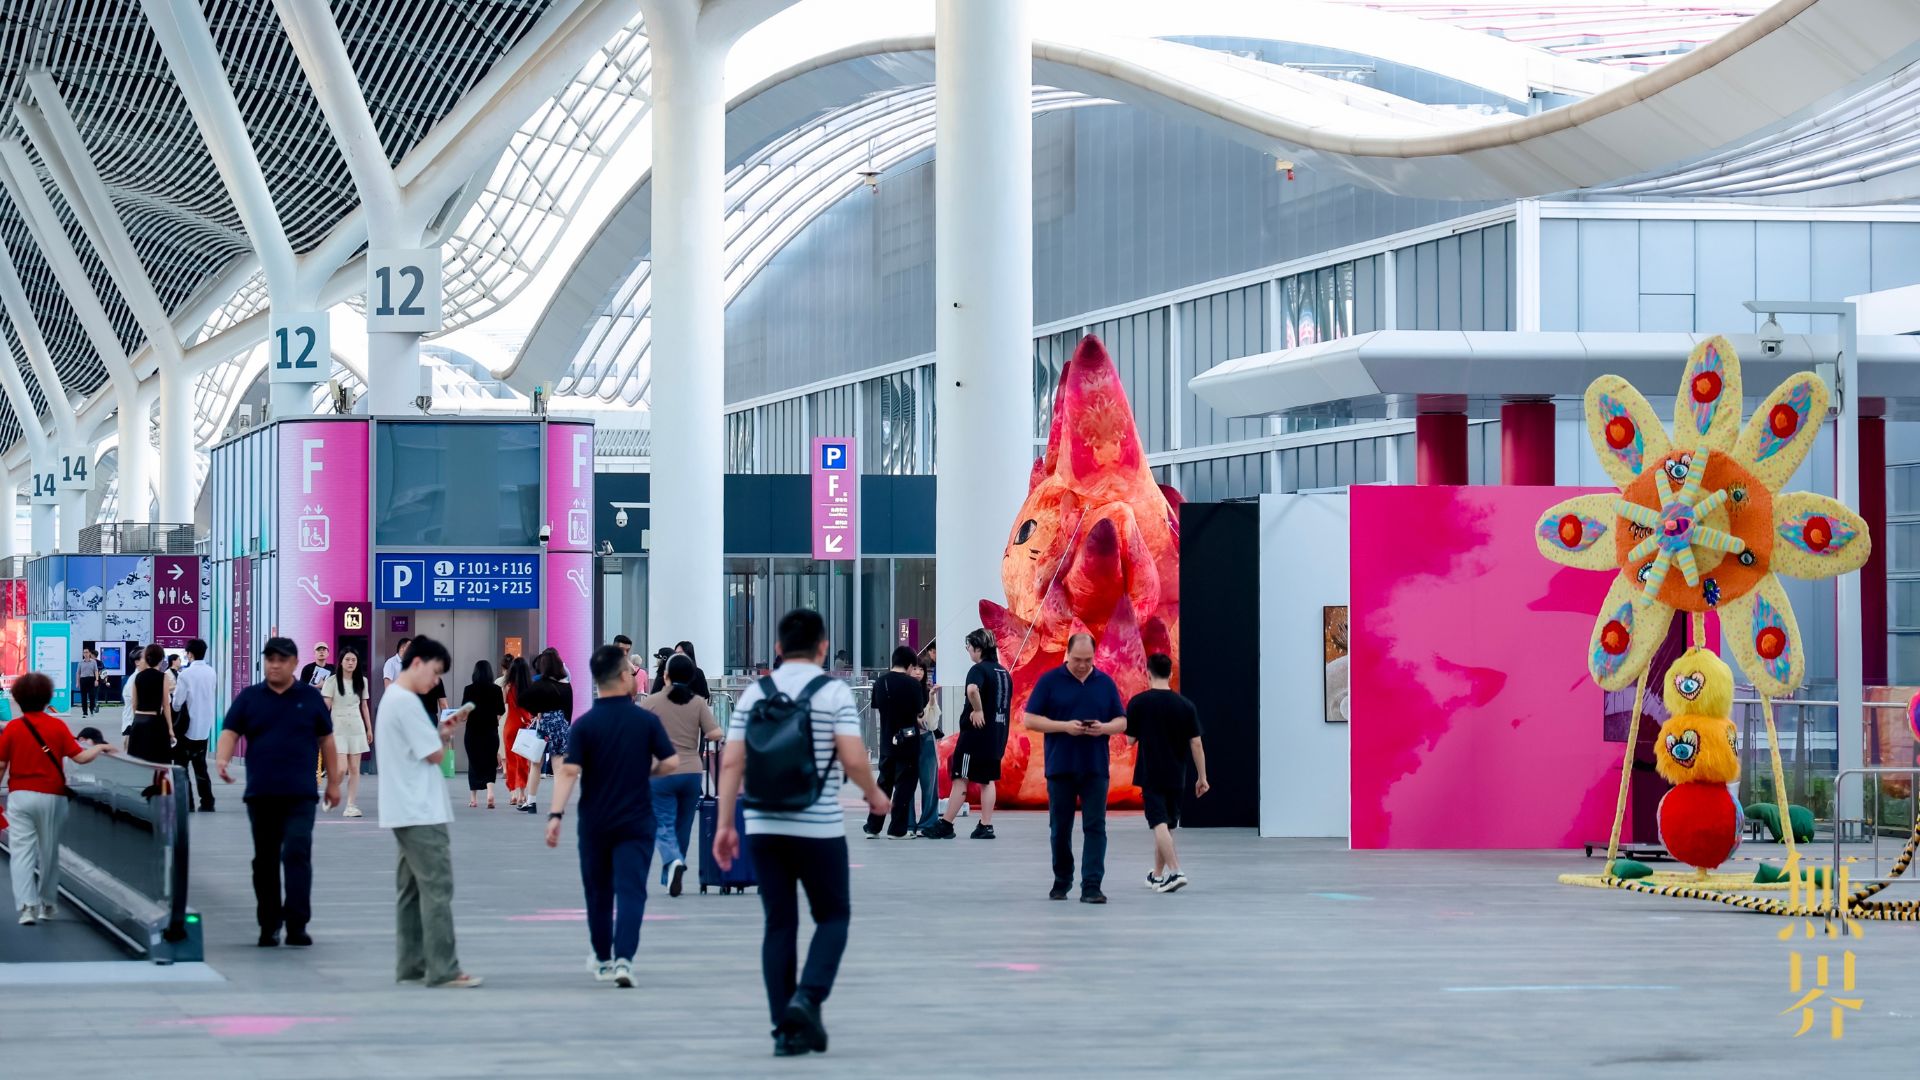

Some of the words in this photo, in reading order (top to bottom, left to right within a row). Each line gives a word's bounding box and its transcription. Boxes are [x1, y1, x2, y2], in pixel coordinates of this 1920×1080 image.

[376, 266, 425, 315] 12
[275, 326, 318, 369] 12
[62, 456, 87, 481] 14
[302, 439, 324, 493] F
[572, 434, 587, 487] F
[827, 447, 841, 466] P
[33, 473, 56, 497] 14
[829, 475, 839, 497] F
[393, 565, 413, 598] P
